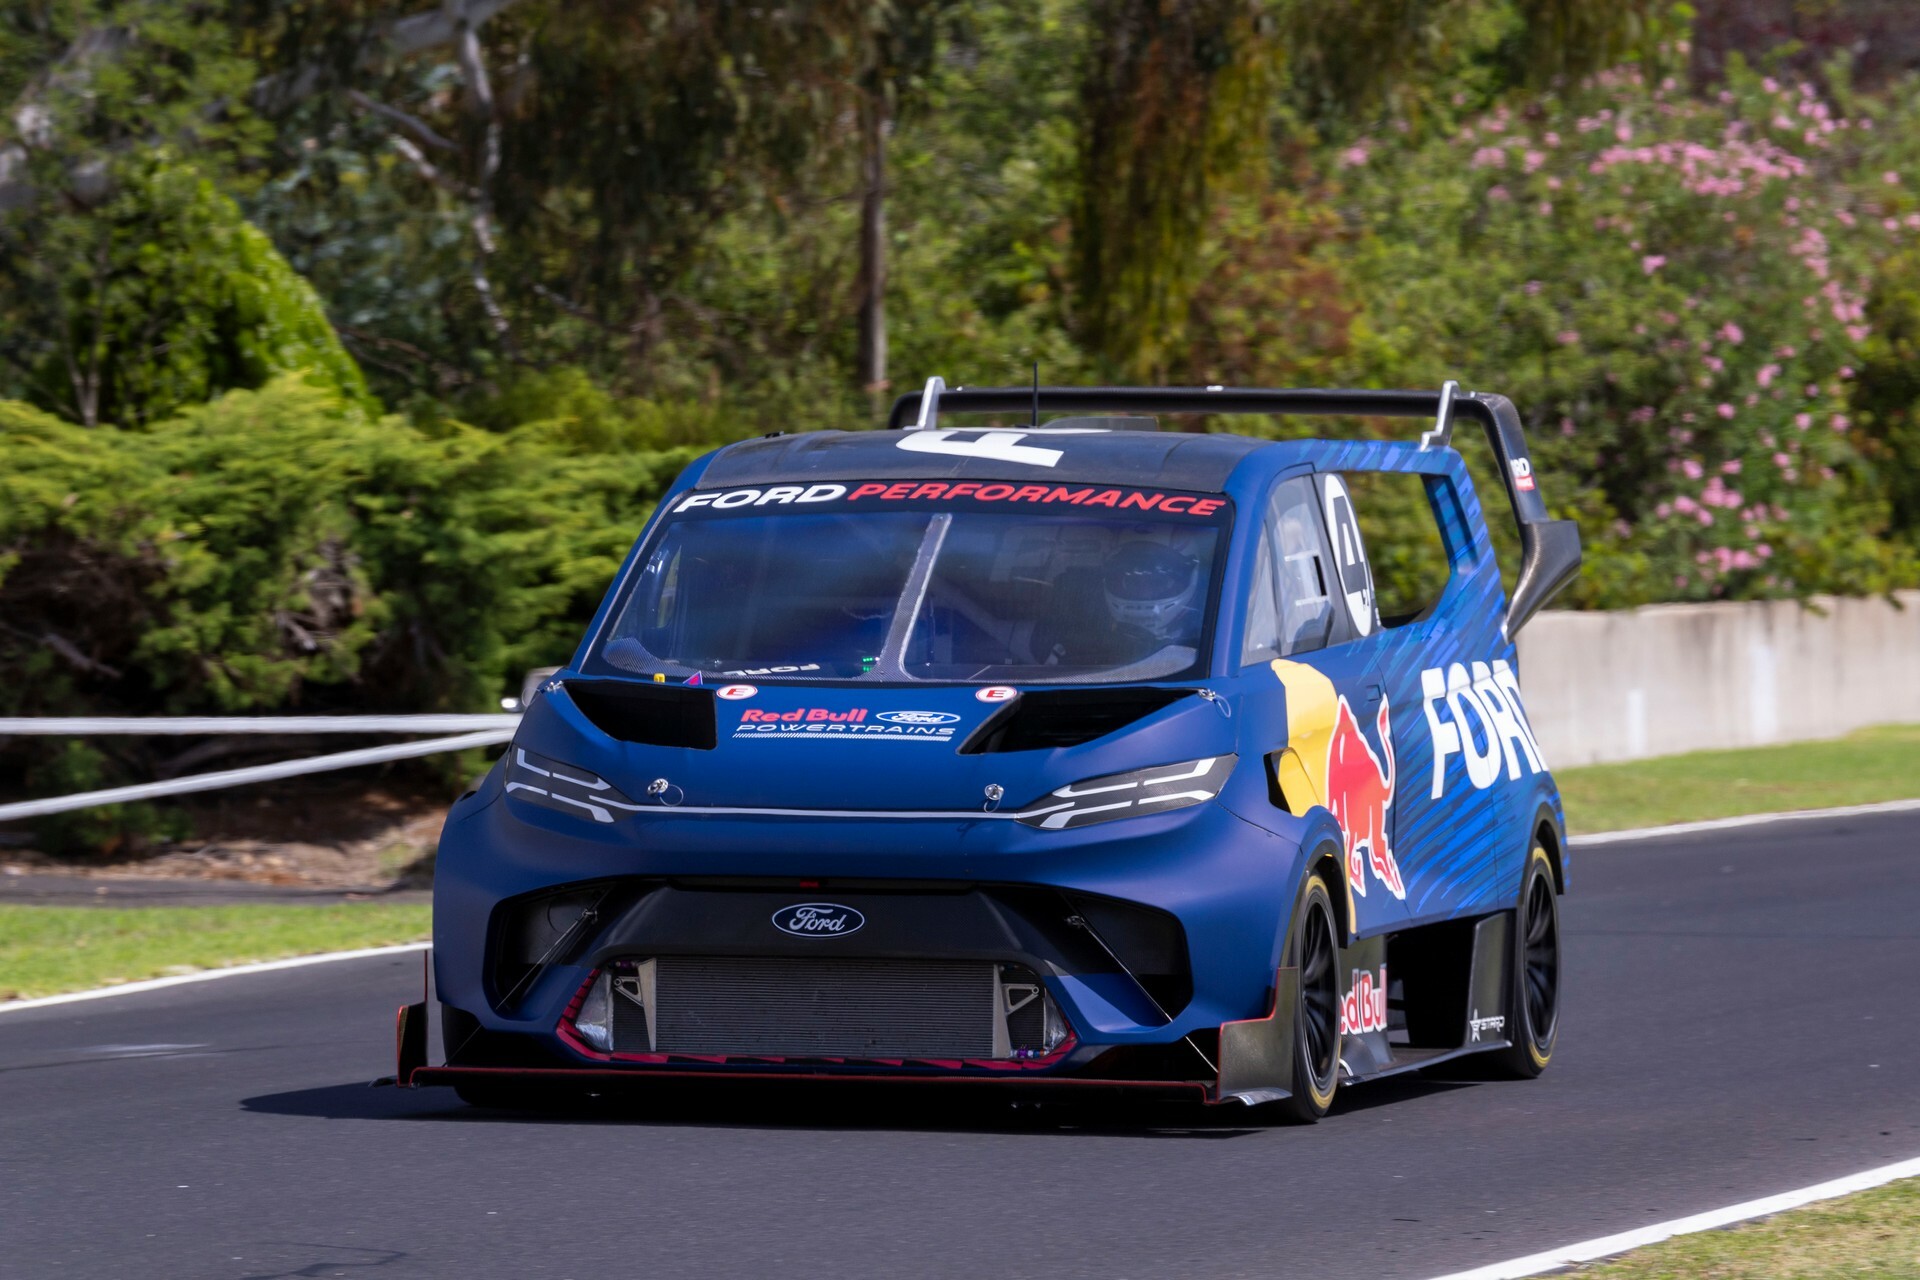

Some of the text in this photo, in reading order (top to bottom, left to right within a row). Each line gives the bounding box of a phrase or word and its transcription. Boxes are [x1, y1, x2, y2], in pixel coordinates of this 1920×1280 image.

[673, 483, 1226, 516] FORD PERFORMANCE
[740, 708, 868, 722] Red Bull
[891, 711, 944, 724] Ford
[736, 724, 956, 736] POWERTRAINS
[788, 906, 847, 932] Ford
